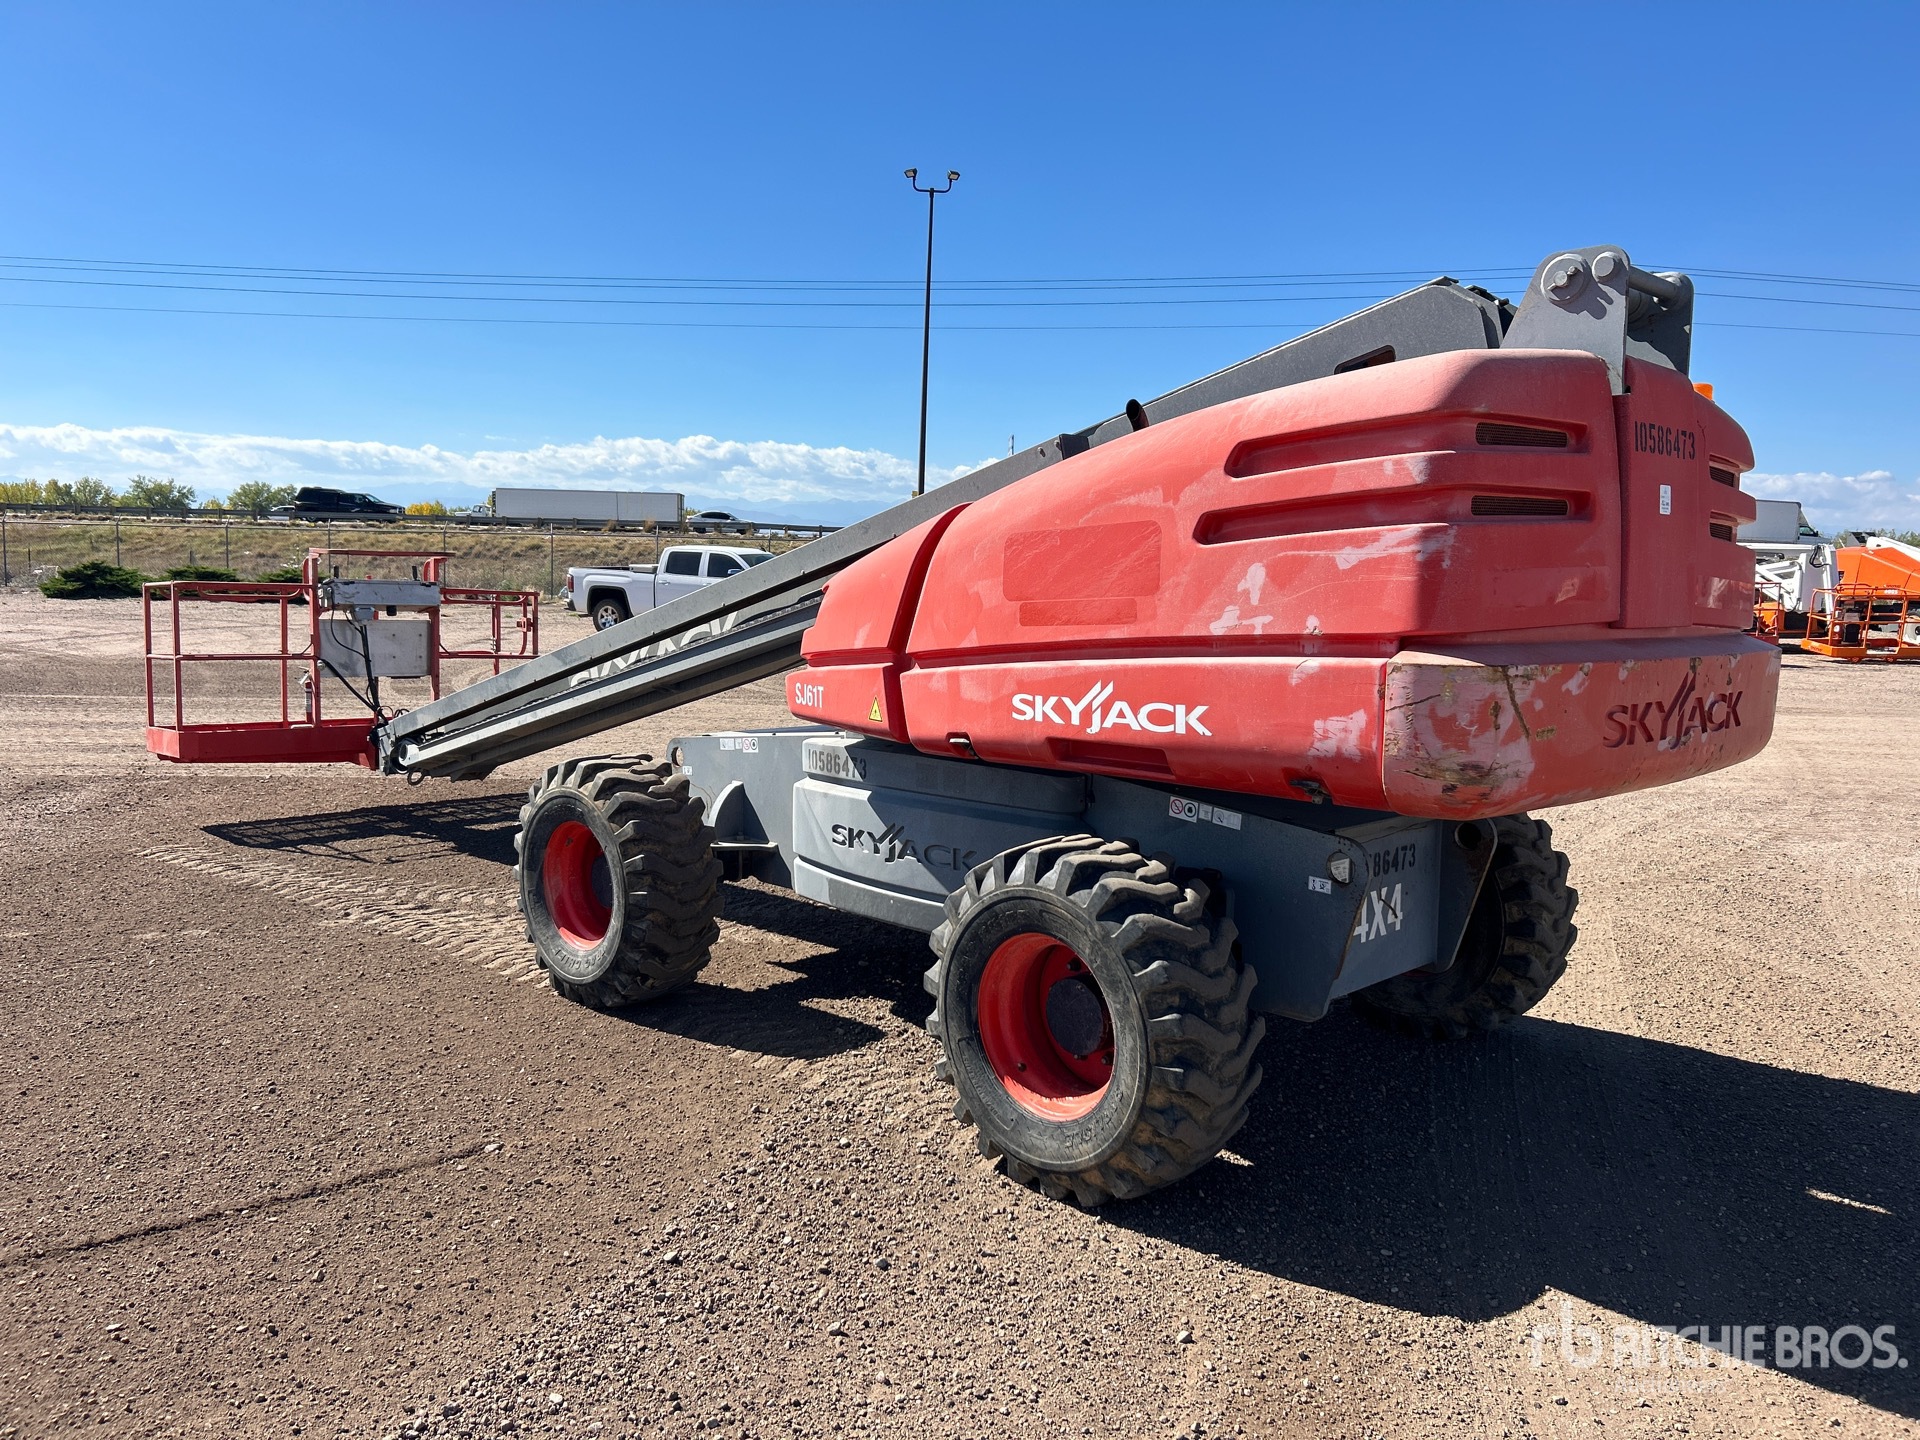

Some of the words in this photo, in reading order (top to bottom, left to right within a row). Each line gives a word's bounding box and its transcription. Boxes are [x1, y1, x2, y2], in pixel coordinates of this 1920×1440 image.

[1634, 421, 1696, 460] 10586473
[794, 682, 824, 709] SJ61T
[1011, 680, 1213, 737] SKYJACK
[1603, 672, 1744, 751] SKYJACK
[807, 748, 867, 780] 10586473
[831, 822, 978, 872] SKYJACK
